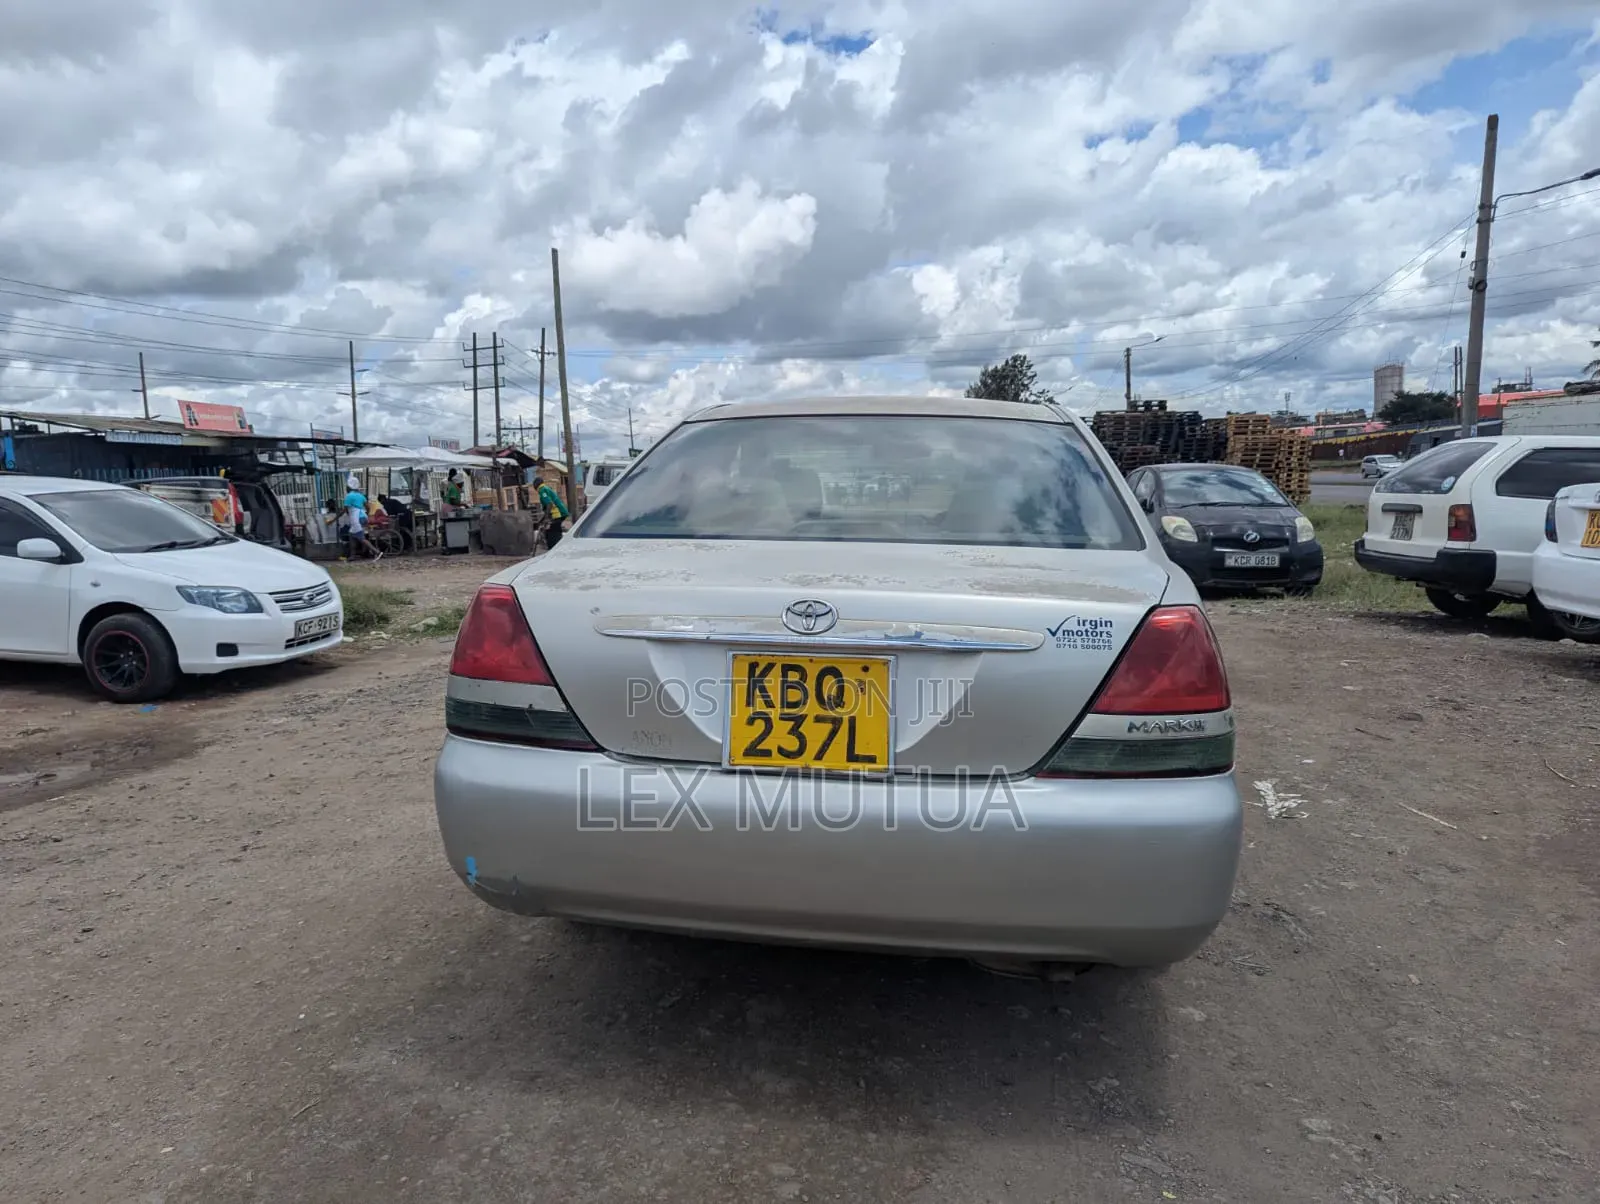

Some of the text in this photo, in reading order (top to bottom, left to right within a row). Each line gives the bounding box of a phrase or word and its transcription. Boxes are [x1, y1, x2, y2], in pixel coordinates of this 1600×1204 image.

[1233, 555, 1252, 566] KCR
[1062, 628, 1113, 638] motors
[745, 661, 845, 711] KBQ
[743, 710, 877, 764] 237L
